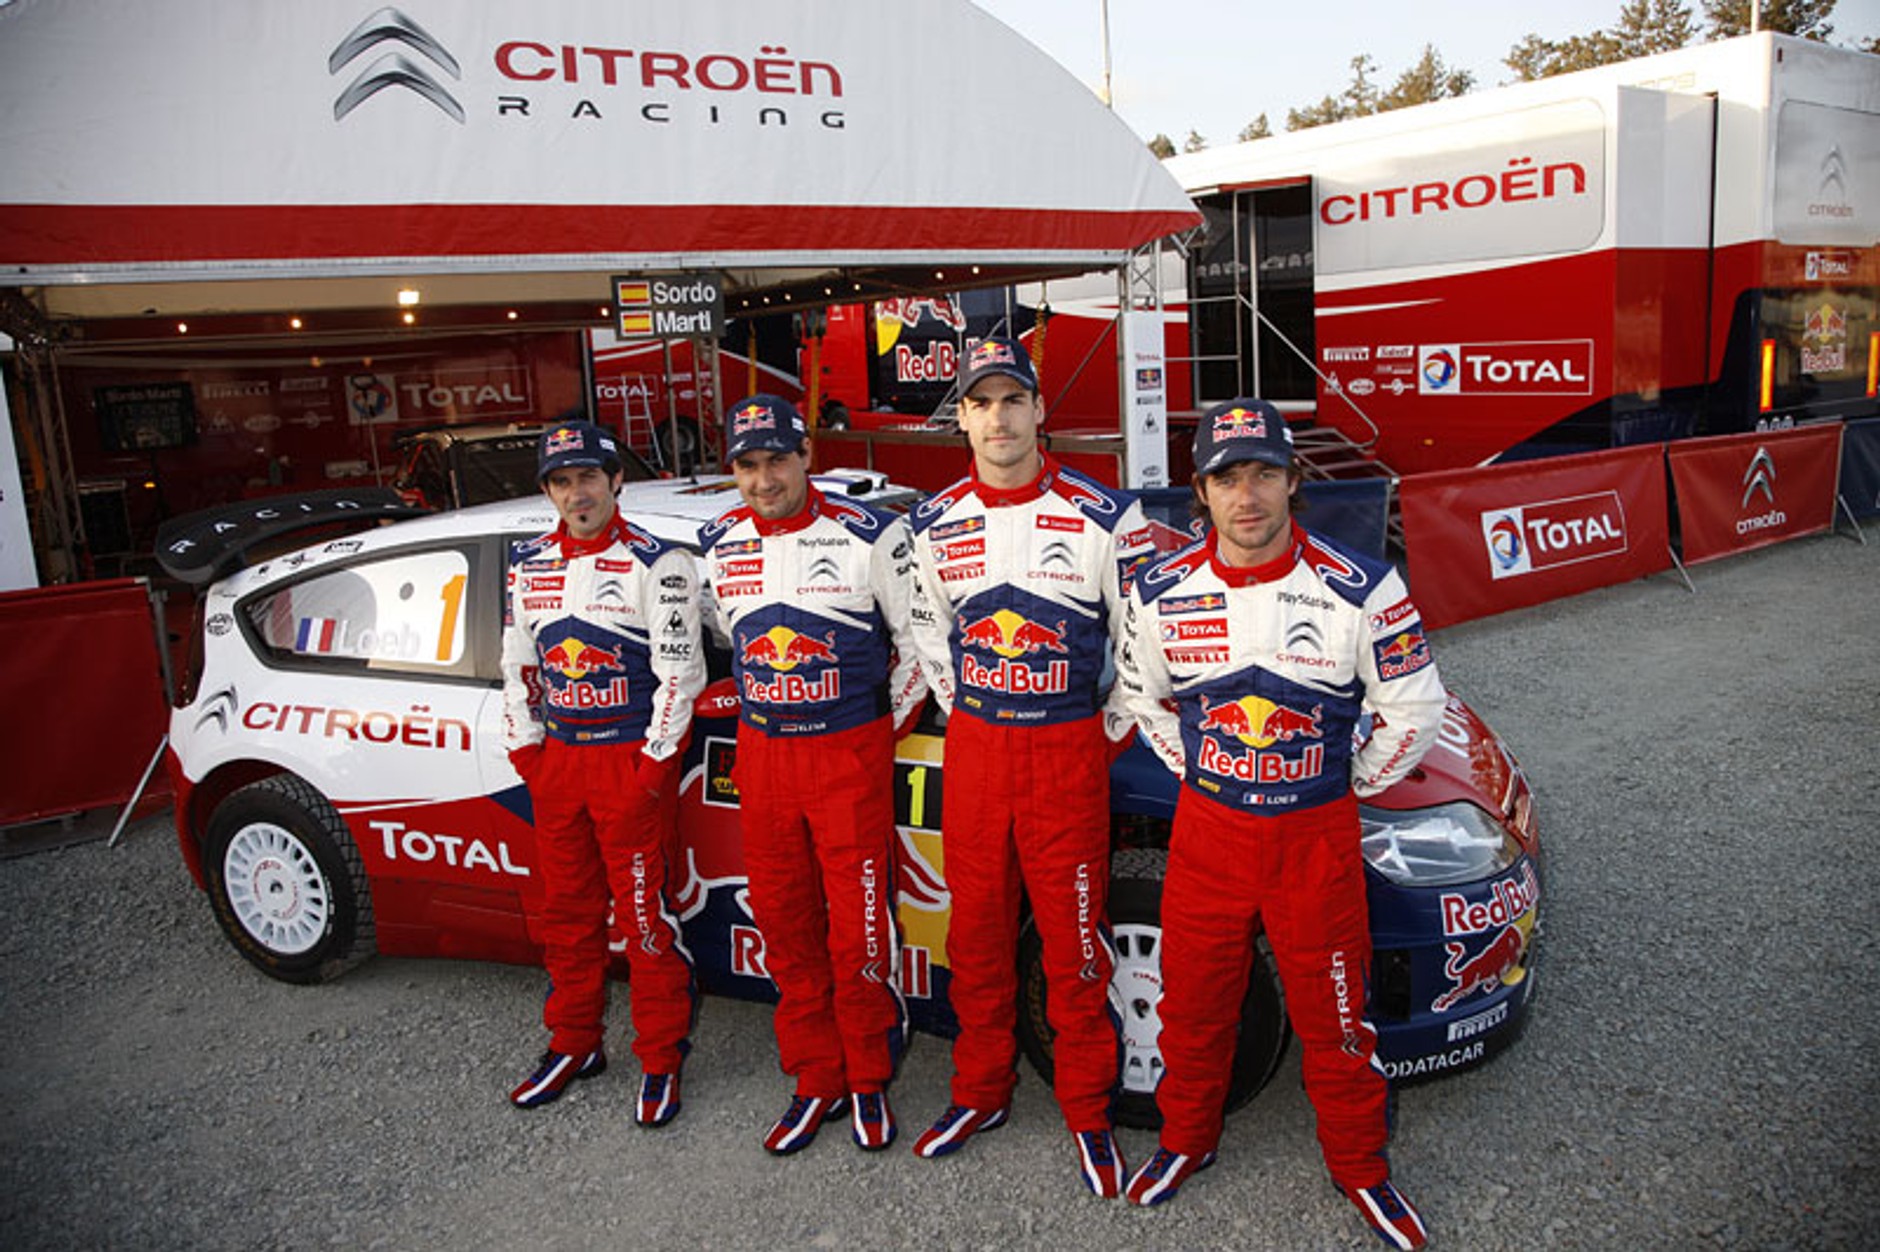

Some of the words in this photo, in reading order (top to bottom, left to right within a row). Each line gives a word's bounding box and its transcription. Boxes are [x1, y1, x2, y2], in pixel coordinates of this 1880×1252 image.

[498, 95, 845, 128] RACING
[1320, 157, 1586, 225] CITROËN
[1818, 259, 1848, 274] TOTAL
[653, 282, 717, 305] Sordo
[895, 341, 938, 382] Red
[1466, 355, 1585, 383] TOTAL
[401, 381, 525, 408] TOTAL
[1527, 513, 1622, 553] TOTAL
[435, 574, 467, 661] 1
[1179, 622, 1225, 636] TOTAL
[575, 677, 628, 709] Bull
[742, 671, 784, 703] Red
[785, 668, 840, 703] Bull
[962, 653, 1008, 692] Red
[1008, 660, 1069, 694] Bull
[242, 704, 471, 752] CITROËN
[1199, 735, 1255, 782] Red
[1257, 743, 1323, 783] Bull
[907, 765, 926, 826] 1
[369, 820, 530, 876] TOTAL
[1441, 882, 1508, 936] Red
[1447, 1002, 1508, 1042] PIRELLI
